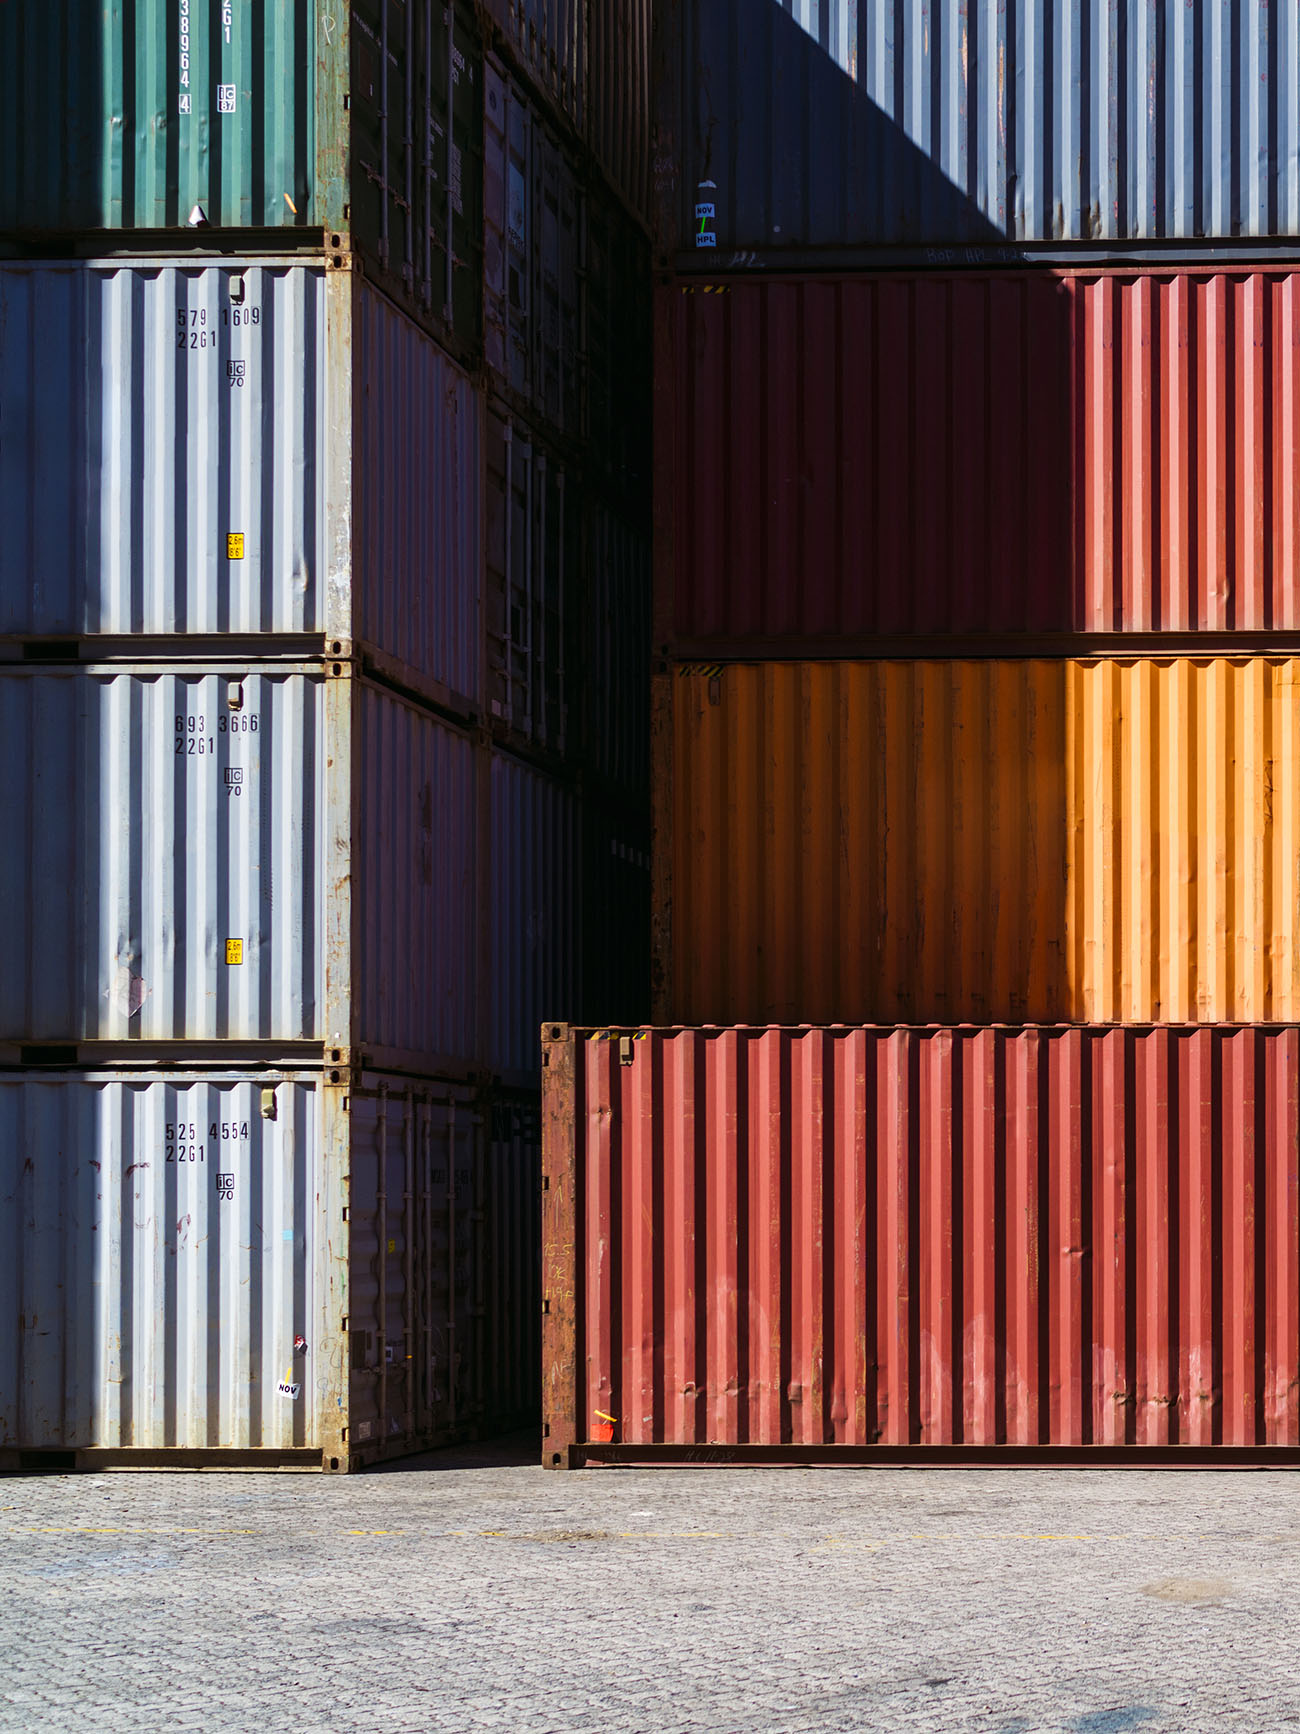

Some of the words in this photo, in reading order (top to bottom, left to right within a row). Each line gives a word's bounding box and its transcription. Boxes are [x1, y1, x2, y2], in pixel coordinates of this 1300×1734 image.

[180, 0, 190, 88] 38964
[177, 308, 206, 326] 579
[222, 307, 260, 326] 1609
[178, 330, 216, 349] 22G1
[229, 377, 244, 387] 70
[175, 715, 205, 733] 693
[218, 713, 259, 733] 3666
[175, 737, 214, 754] 22G1
[226, 785, 241, 796] 70
[166, 1123, 195, 1140] 525
[209, 1122, 249, 1139] 4554
[166, 1144, 204, 1162] 22G1
[218, 1190, 234, 1200] 70
[278, 1383, 297, 1394] NOV
